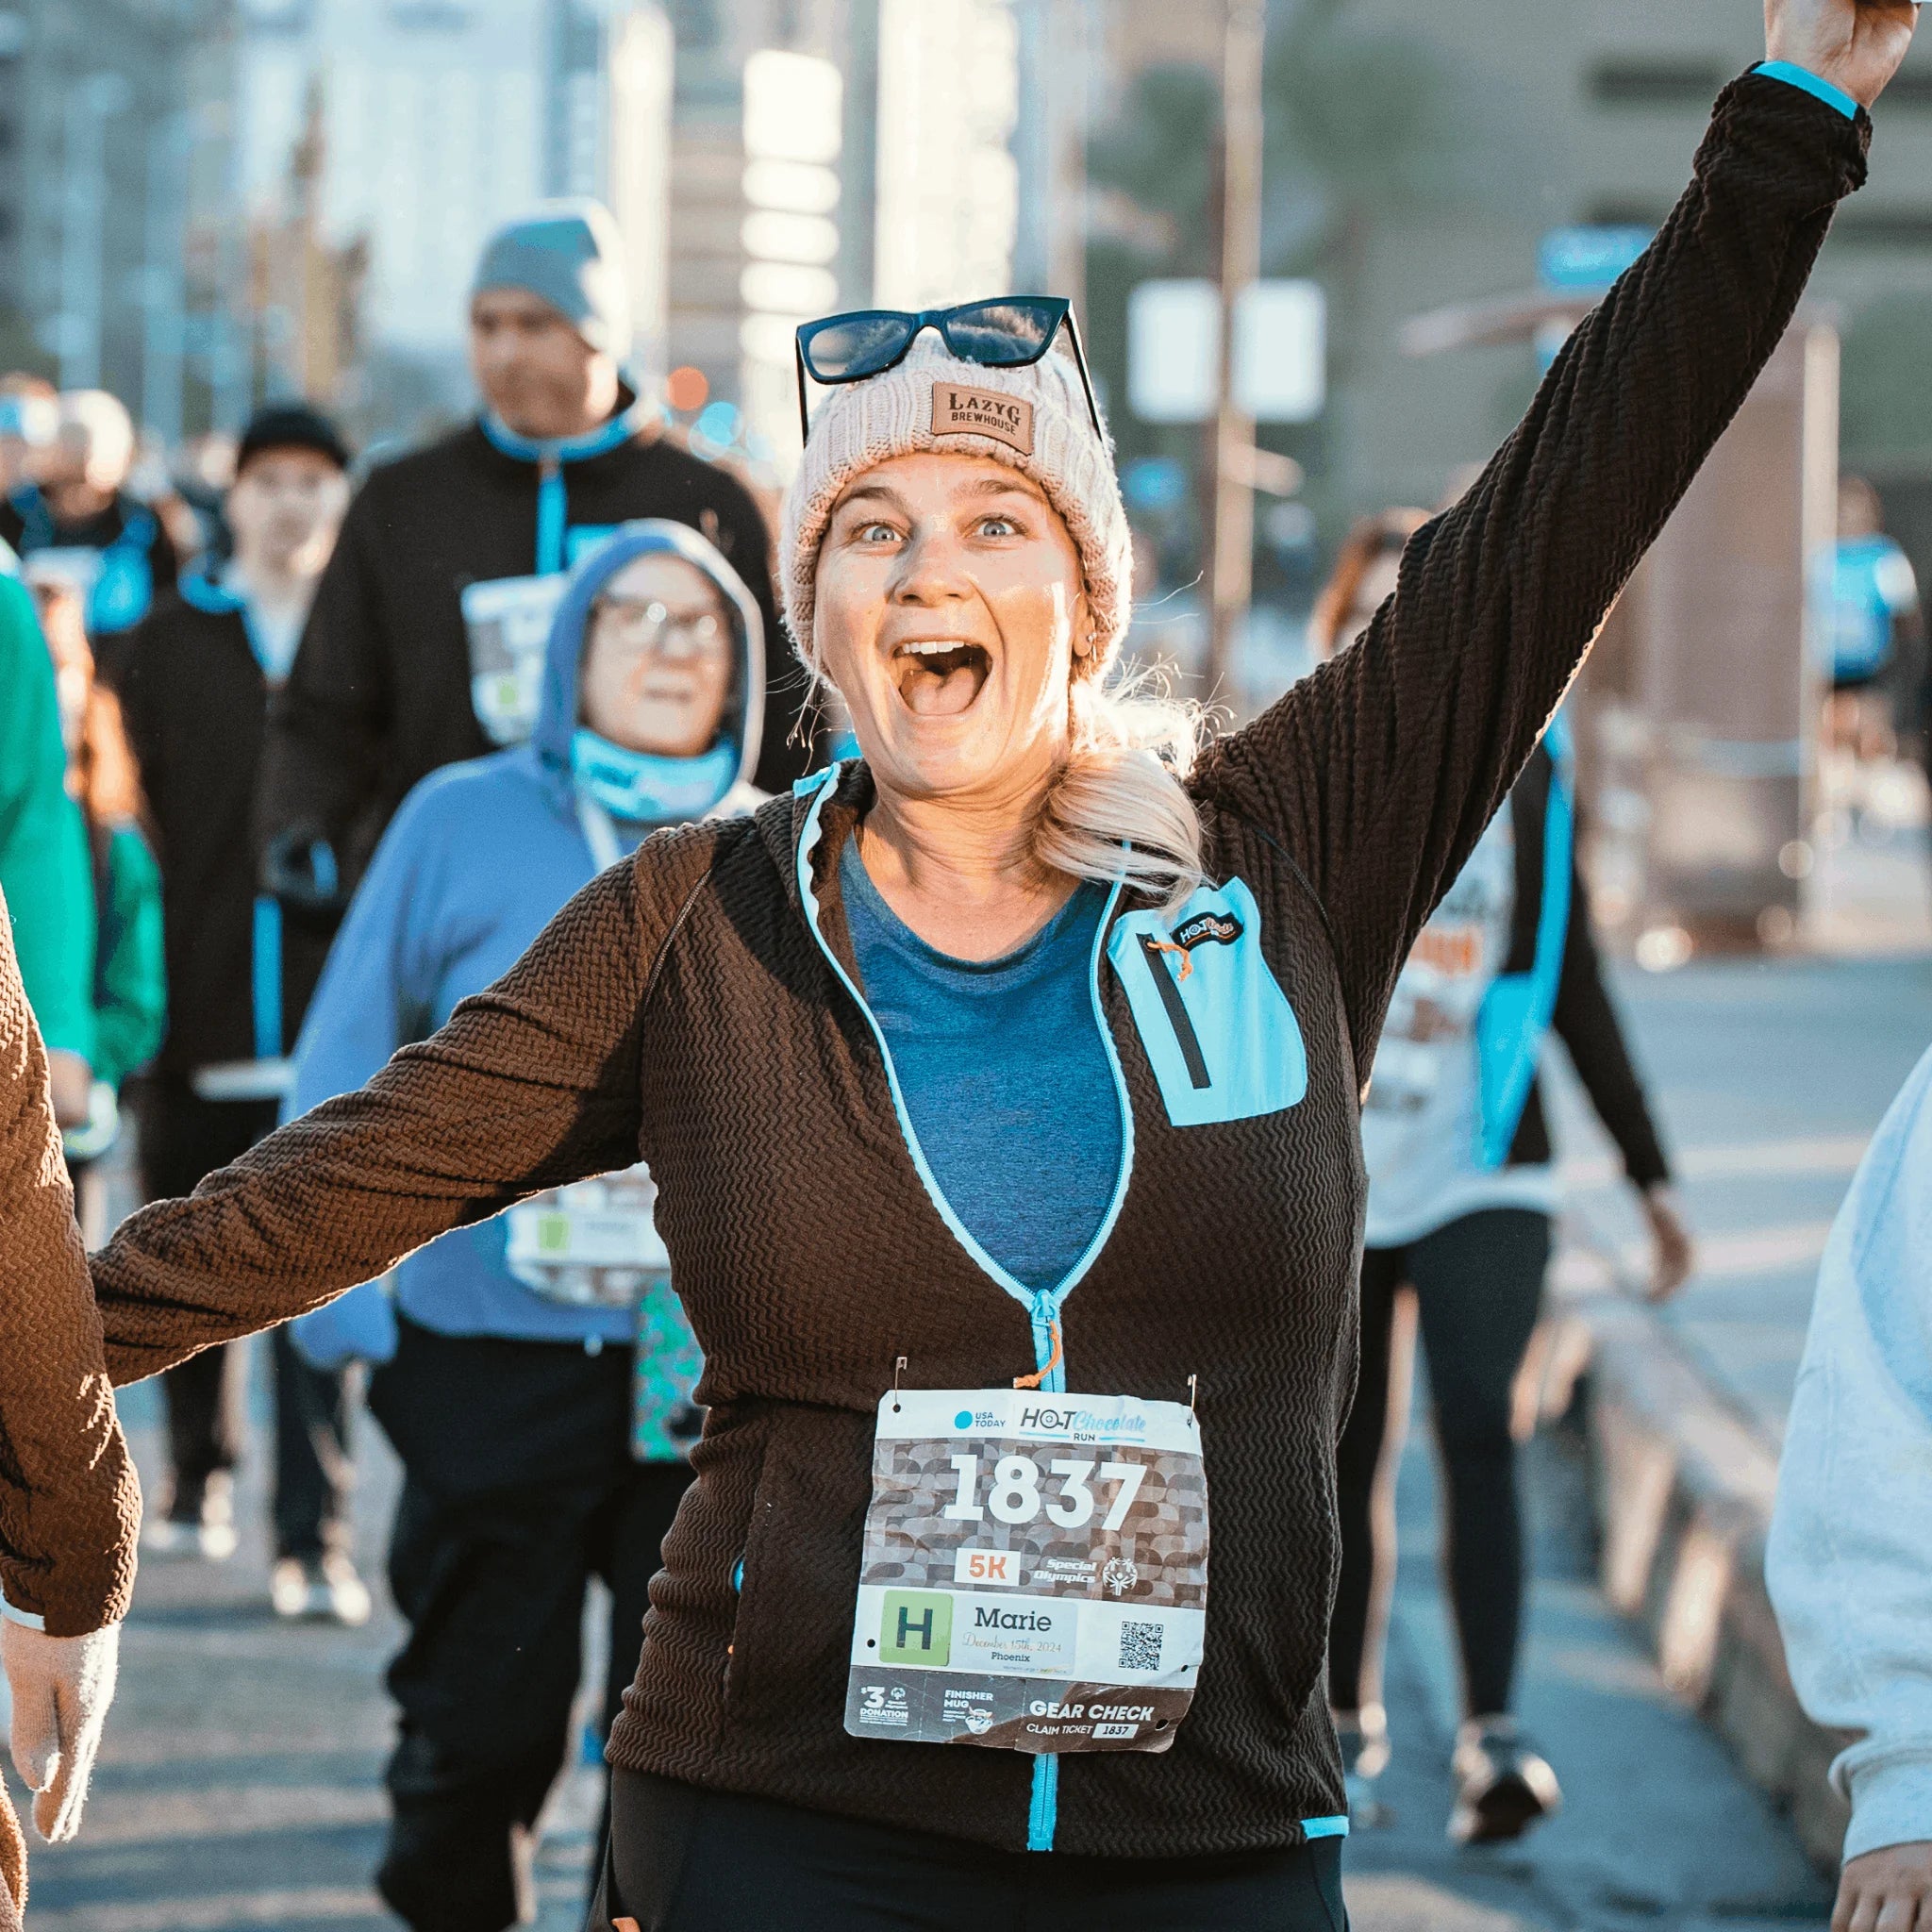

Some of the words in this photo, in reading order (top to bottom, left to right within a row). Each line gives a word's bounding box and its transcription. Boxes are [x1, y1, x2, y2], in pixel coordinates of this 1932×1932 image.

[951, 411, 1016, 436] BREWHOUSE
[975, 1411, 993, 1420] USA
[1020, 1407, 1077, 1430] HOT
[1073, 1410, 1146, 1433] Chocolate
[974, 1419, 1006, 1427] TODAY
[1073, 1433, 1095, 1441] RUN
[944, 1454, 1147, 1531] 1837
[969, 1554, 1008, 1579] 5K
[1046, 1558, 1097, 1572] Special
[1033, 1570, 1096, 1584] Olympics
[974, 1607, 1052, 1632] Marie
[896, 1607, 934, 1650] H
[962, 1632, 1008, 1650] December
[1037, 1641, 1061, 1653] 2024
[991, 1652, 1031, 1662] Phoenix
[945, 1690, 993, 1701] FINISHER
[943, 1699, 970, 1708] MUG
[859, 1707, 908, 1718] DONATION
[1029, 1700, 1084, 1719] GEAR
[1088, 1704, 1155, 1722] CHECK
[1026, 1723, 1059, 1735] CLAIM
[1061, 1724, 1093, 1734] TICKET
[1102, 1725, 1129, 1735] 1837
